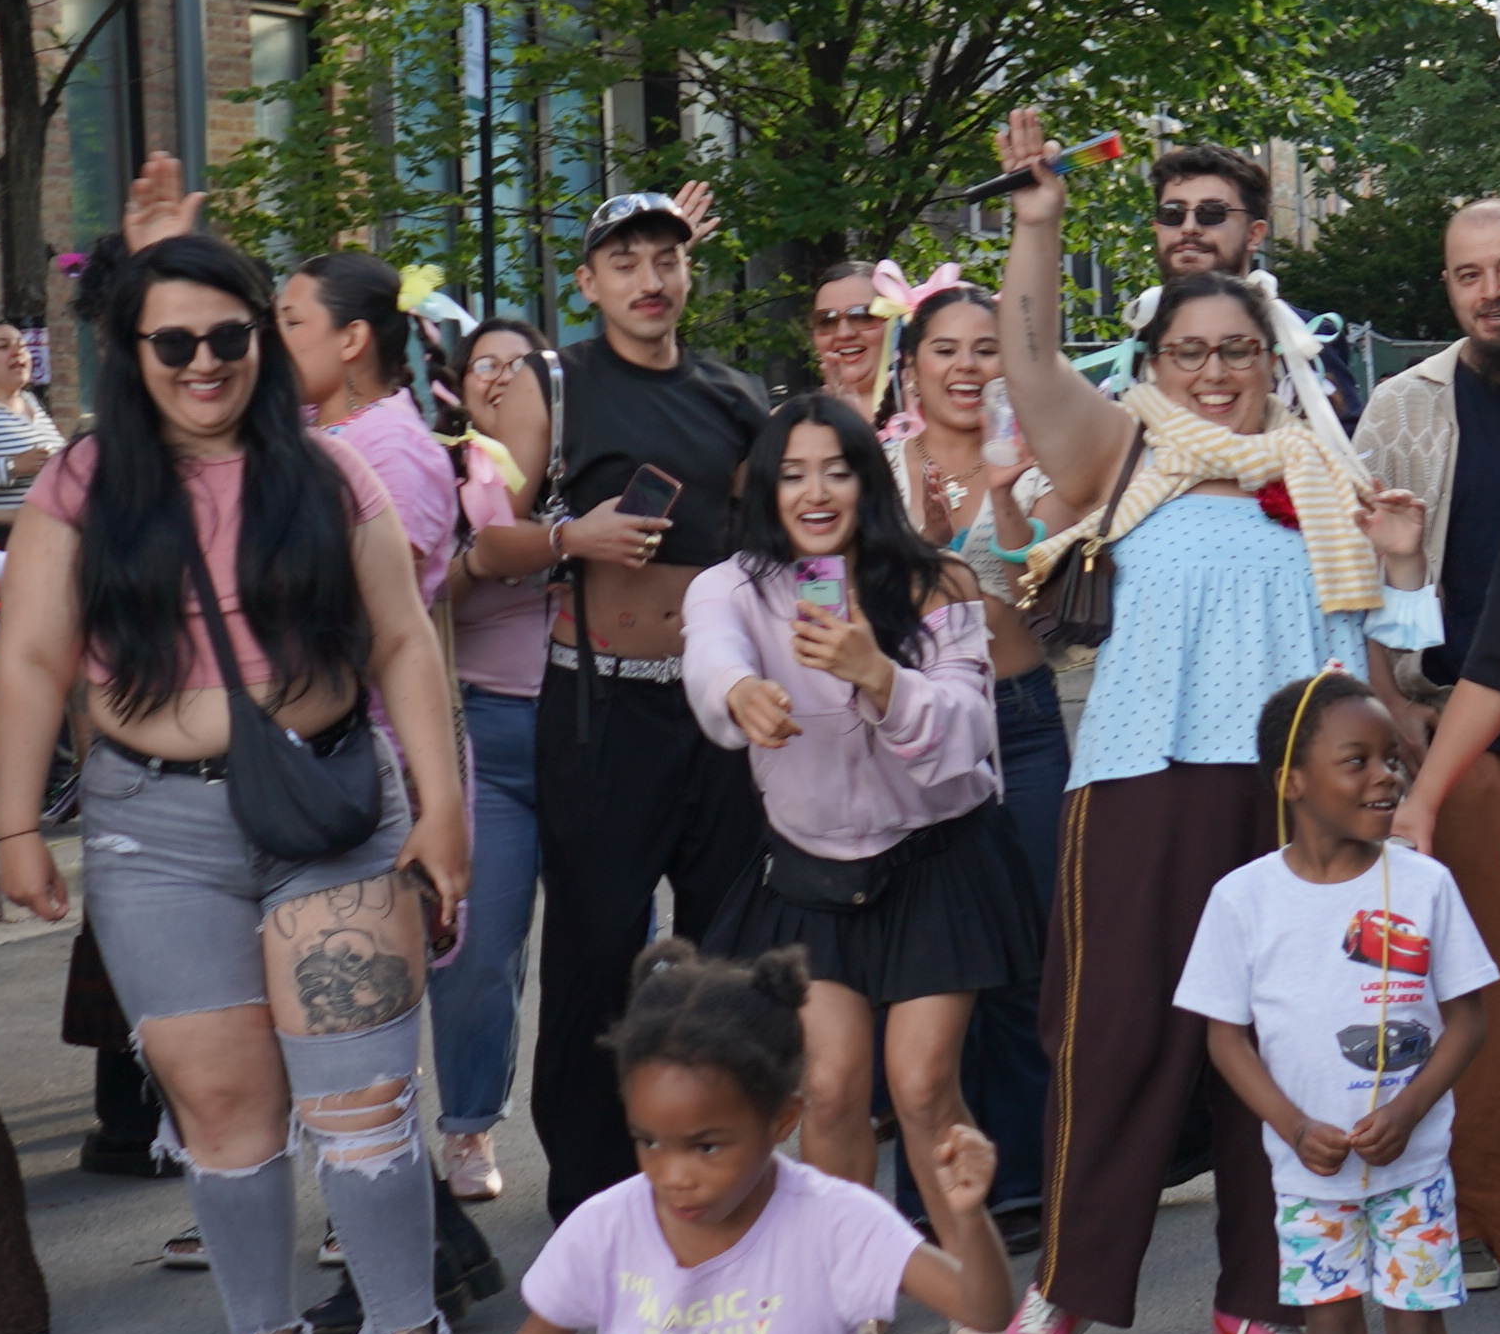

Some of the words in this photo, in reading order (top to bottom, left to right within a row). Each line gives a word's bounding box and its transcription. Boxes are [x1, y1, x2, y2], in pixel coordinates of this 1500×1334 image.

[619, 1271, 655, 1294] THE
[636, 1288, 749, 1329] MAGIC
[756, 1294, 783, 1314] OF
